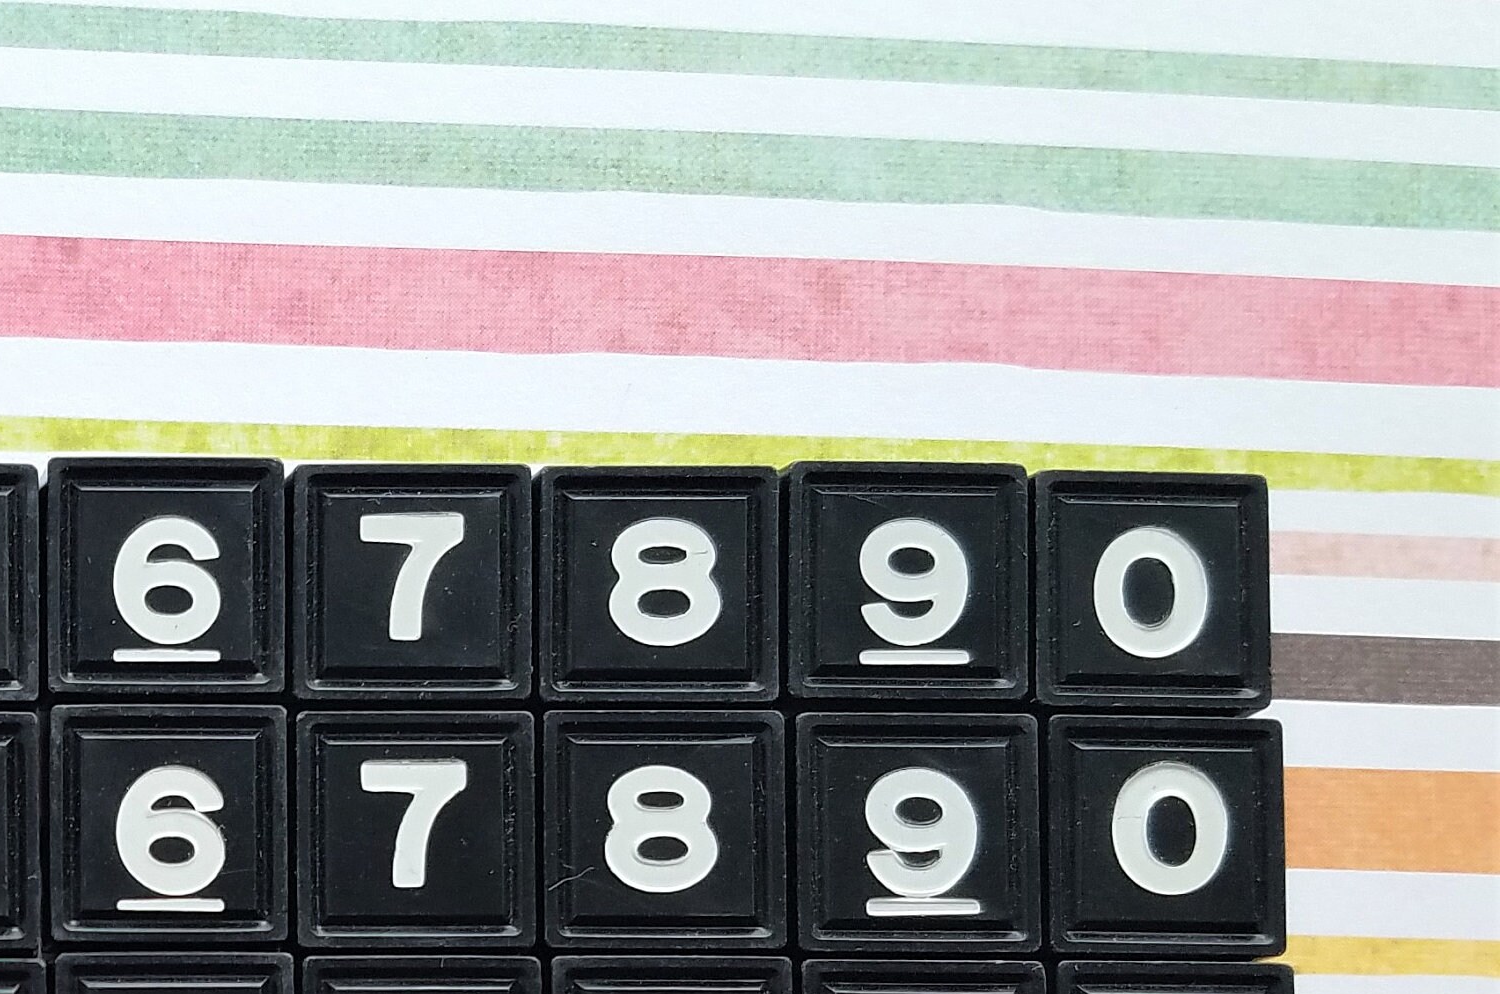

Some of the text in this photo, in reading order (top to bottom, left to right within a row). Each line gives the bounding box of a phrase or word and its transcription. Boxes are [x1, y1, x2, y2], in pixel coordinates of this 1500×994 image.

[112, 514, 221, 645] 6
[359, 511, 465, 641] 7
[608, 516, 723, 647] 8
[859, 517, 969, 647] 9
[1093, 525, 1210, 659] 0
[115, 765, 226, 896] 6
[360, 759, 468, 888] 7
[604, 764, 719, 893] 8
[864, 767, 984, 899] 9
[1111, 760, 1229, 896] 0
